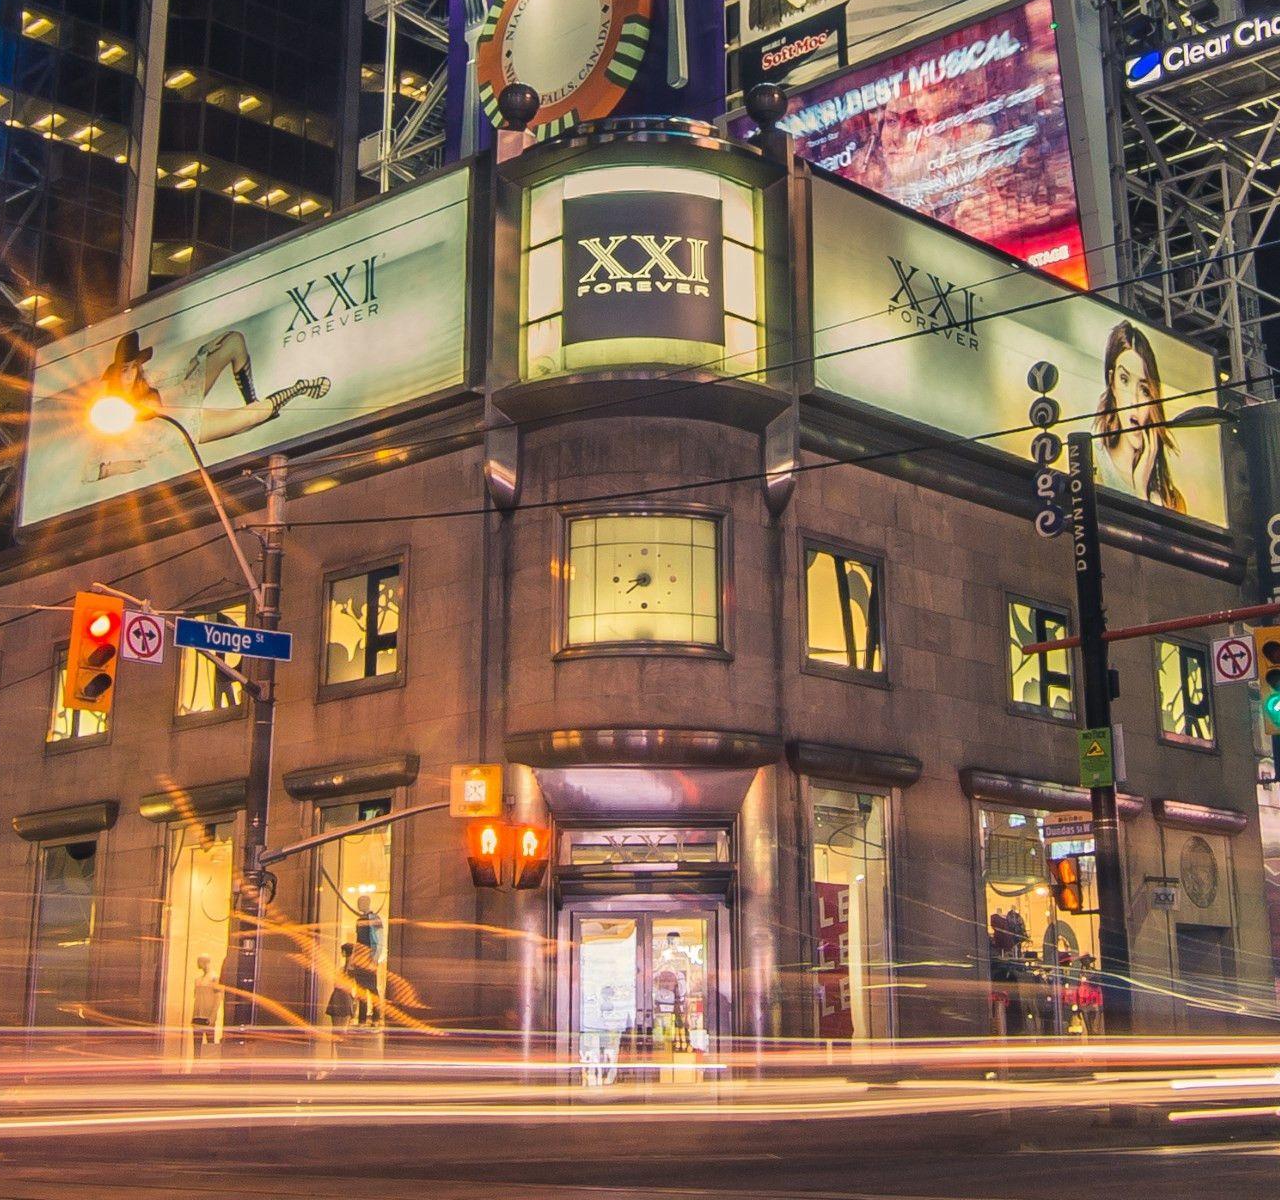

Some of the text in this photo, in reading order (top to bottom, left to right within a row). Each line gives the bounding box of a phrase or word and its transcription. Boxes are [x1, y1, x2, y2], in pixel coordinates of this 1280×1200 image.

[578, 19, 611, 81] CANADA
[762, 32, 827, 70] SoftMoc
[1162, 31, 1231, 72] Clear
[578, 235, 710, 284] XXI
[285, 254, 381, 335] XXI
[577, 280, 710, 298] FOREVER
[887, 255, 979, 336] XXI
[282, 303, 381, 349] FOREVER
[887, 304, 980, 352] FOREVER
[1070, 444, 1088, 572] DOWNTOWN
[204, 624, 265, 650] Yonge St
[602, 834, 688, 864] XXI
[1045, 825, 1075, 837] Dundas
